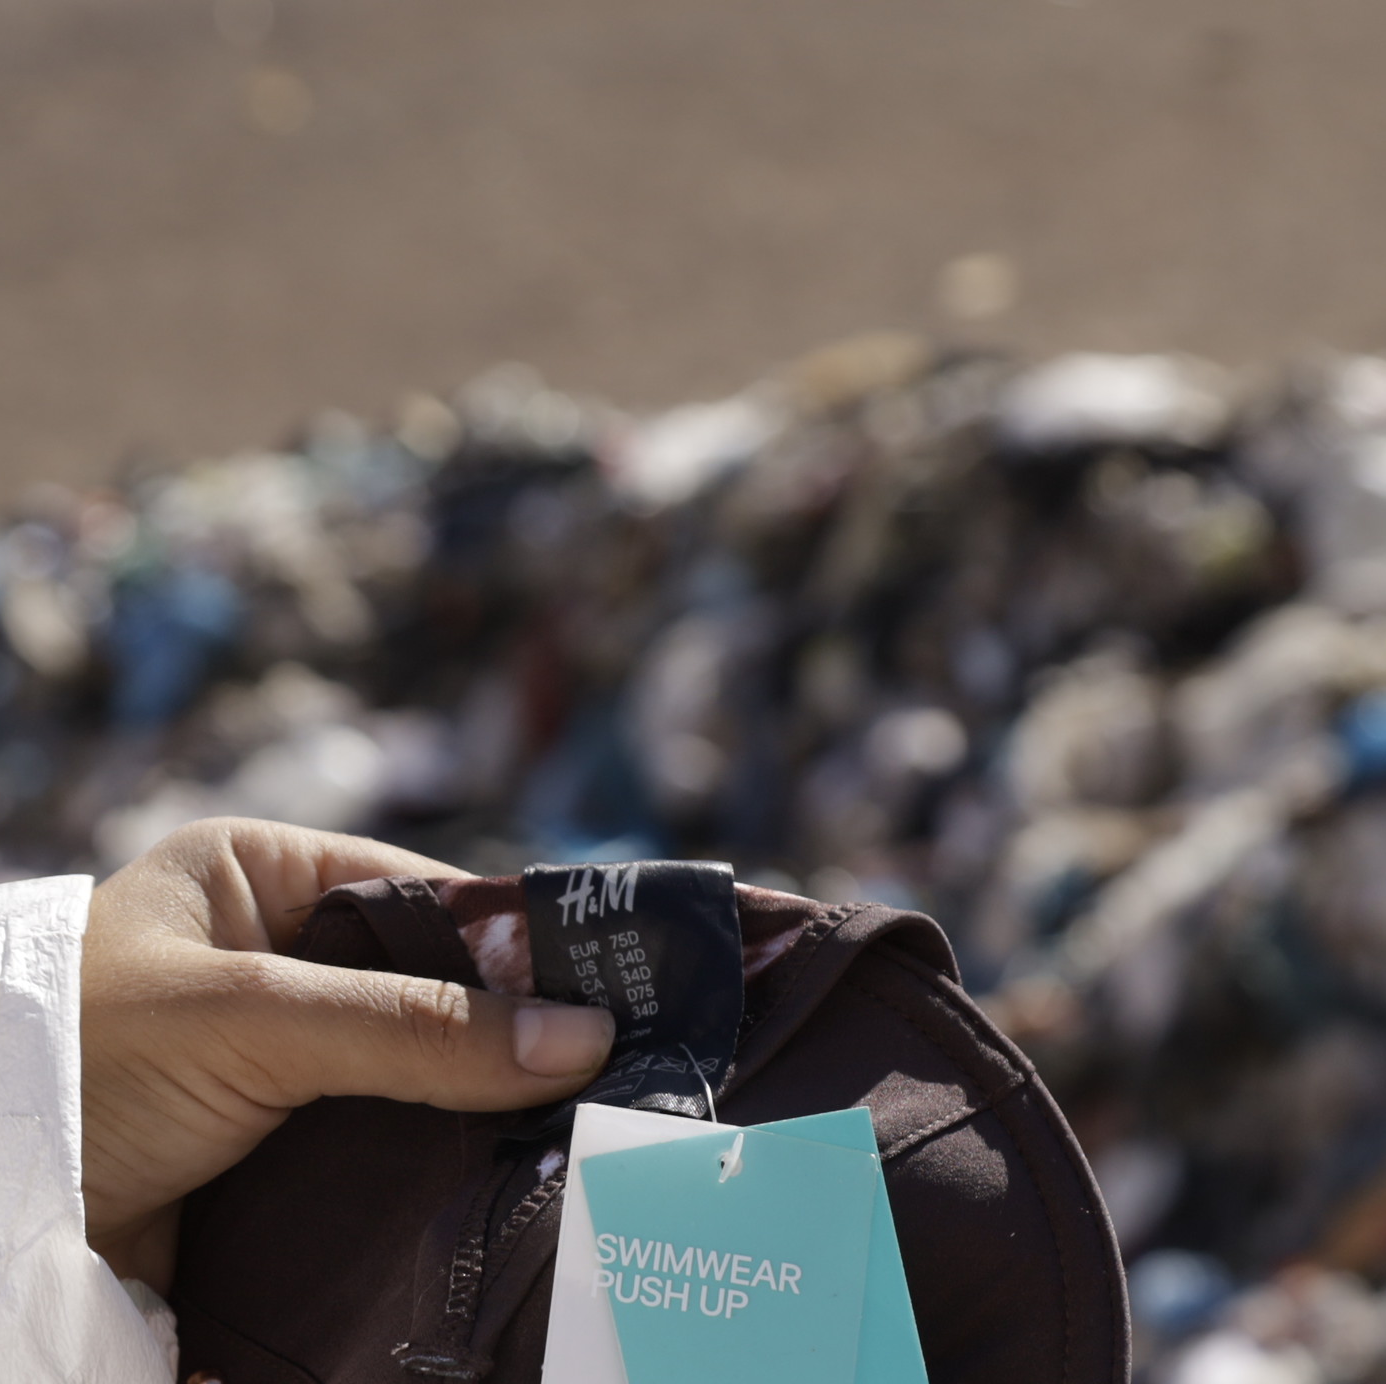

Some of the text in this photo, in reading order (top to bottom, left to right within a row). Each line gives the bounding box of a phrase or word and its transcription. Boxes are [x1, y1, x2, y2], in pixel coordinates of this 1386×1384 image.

[556, 864, 640, 927] H&M
[569, 930, 640, 961] EUR 75D
[574, 947, 646, 978] US 34D
[581, 965, 652, 995] CA 34D
[625, 983, 655, 1003] D75
[631, 1000, 659, 1021] 34D
[594, 1233, 803, 1295] SWIMWEAR
[590, 1268, 749, 1320] PUSH UP
